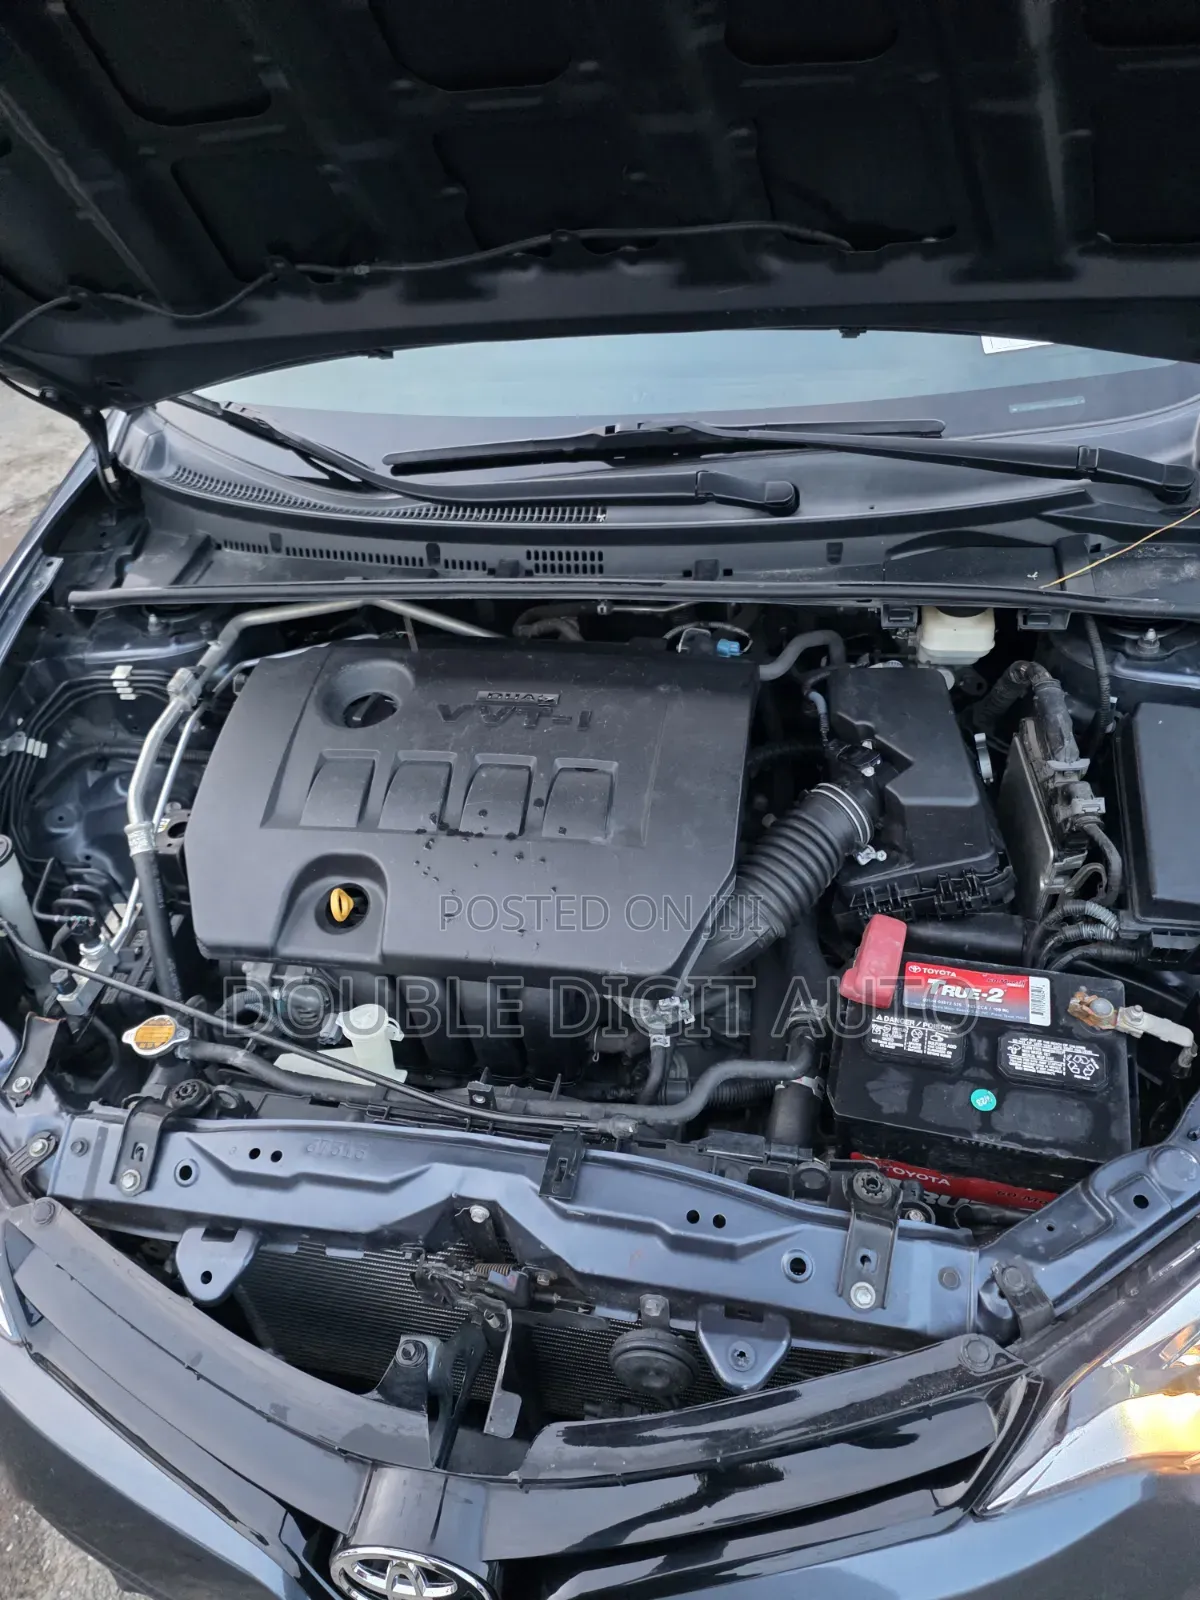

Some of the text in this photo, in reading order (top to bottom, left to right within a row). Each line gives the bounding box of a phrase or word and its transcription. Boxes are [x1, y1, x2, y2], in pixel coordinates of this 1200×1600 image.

[922, 967, 957, 978] TOYOTA
[883, 1015, 915, 1026] DANGER
[922, 1022, 952, 1032] POISON
